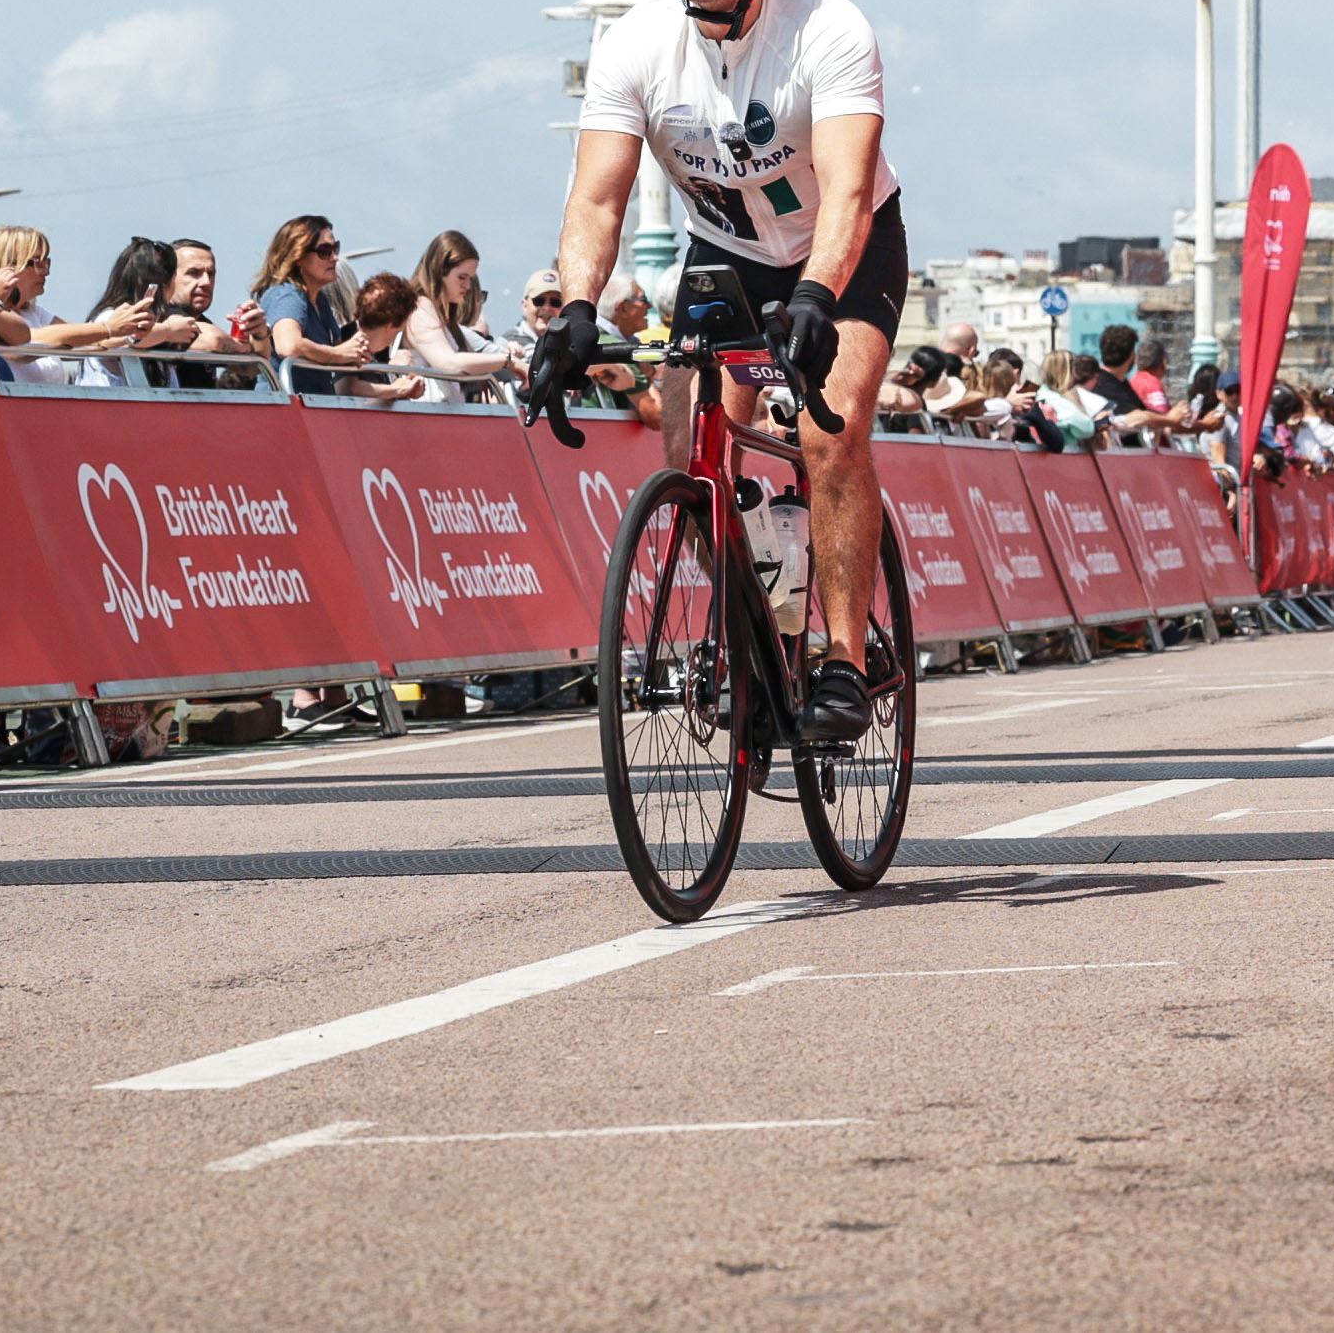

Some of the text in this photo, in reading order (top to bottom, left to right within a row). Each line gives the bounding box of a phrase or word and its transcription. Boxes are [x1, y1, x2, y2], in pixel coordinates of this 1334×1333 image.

[673, 147, 706, 172] FOR
[752, 144, 796, 173] PAPA
[748, 366, 786, 380] 506
[156, 484, 298, 537] British Heart
[419, 487, 527, 534] British Heart
[178, 554, 311, 610] Foundation
[441, 550, 544, 598] Foundation
